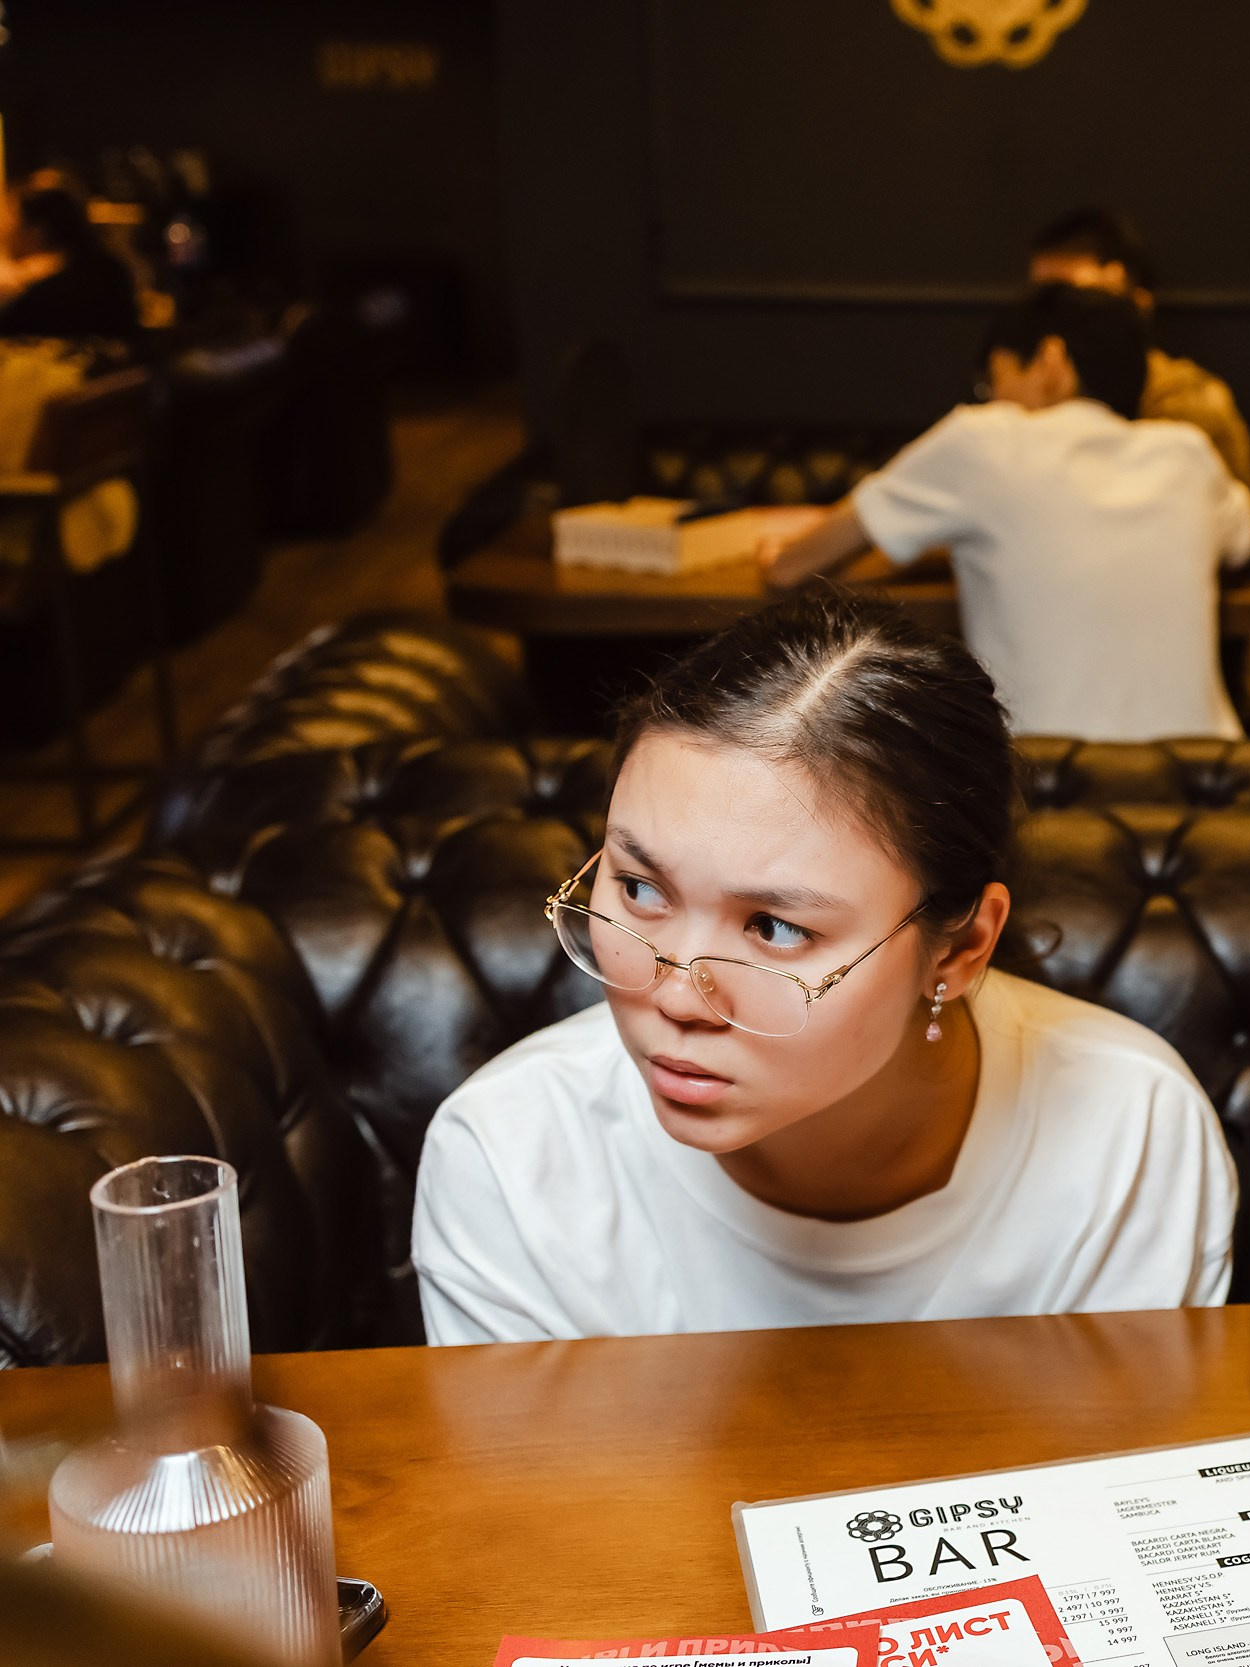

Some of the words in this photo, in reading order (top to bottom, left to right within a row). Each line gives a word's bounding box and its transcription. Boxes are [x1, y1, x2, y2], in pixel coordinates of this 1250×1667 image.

[908, 1496, 1023, 1528] GIPSY
[1120, 1509, 1161, 1520] SAMBUCA
[990, 1517, 1031, 1526] KITCHEN
[1131, 1536, 1168, 1547] BACARDI
[1171, 1532, 1196, 1541] CARTA
[1198, 1527, 1227, 1536] NEGRA
[1134, 1543, 1171, 1553] BACARDI
[1173, 1538, 1199, 1547] CARTA
[1202, 1533, 1236, 1543] BLANCA
[868, 1529, 1031, 1583] BAR
[1138, 1550, 1175, 1560] BACARDI
[1177, 1541, 1222, 1554] OAKHEART
[1140, 1557, 1172, 1567] SAILOR
[1174, 1553, 1198, 1562] JERRY
[1200, 1549, 1220, 1557] RUM
[1152, 1577, 1193, 1589] HENNESY
[1155, 1585, 1197, 1596] HENNESY
[1063, 1593, 1084, 1602] 1797
[1100, 1588, 1116, 1596] 997
[1159, 1592, 1192, 1603] ARARAT
[1162, 1594, 1221, 1610] KAZAKHSTAN
[1066, 1603, 1082, 1612] 497
[1104, 1597, 1120, 1606] 997
[1165, 1602, 1225, 1617] KAZAKHSTAN
[1070, 1613, 1087, 1622] 297
[1108, 1607, 1124, 1615] 997
[1170, 1612, 1213, 1624] ASKANELI
[910, 1611, 1011, 1649] ЛИСТ
[1116, 1626, 1133, 1634] 997
[1173, 1619, 1217, 1631] ASKANELI
[1121, 1635, 1138, 1643] 997
[1186, 1648, 1212, 1657] LONG
[1213, 1642, 1246, 1652] ISLAND
